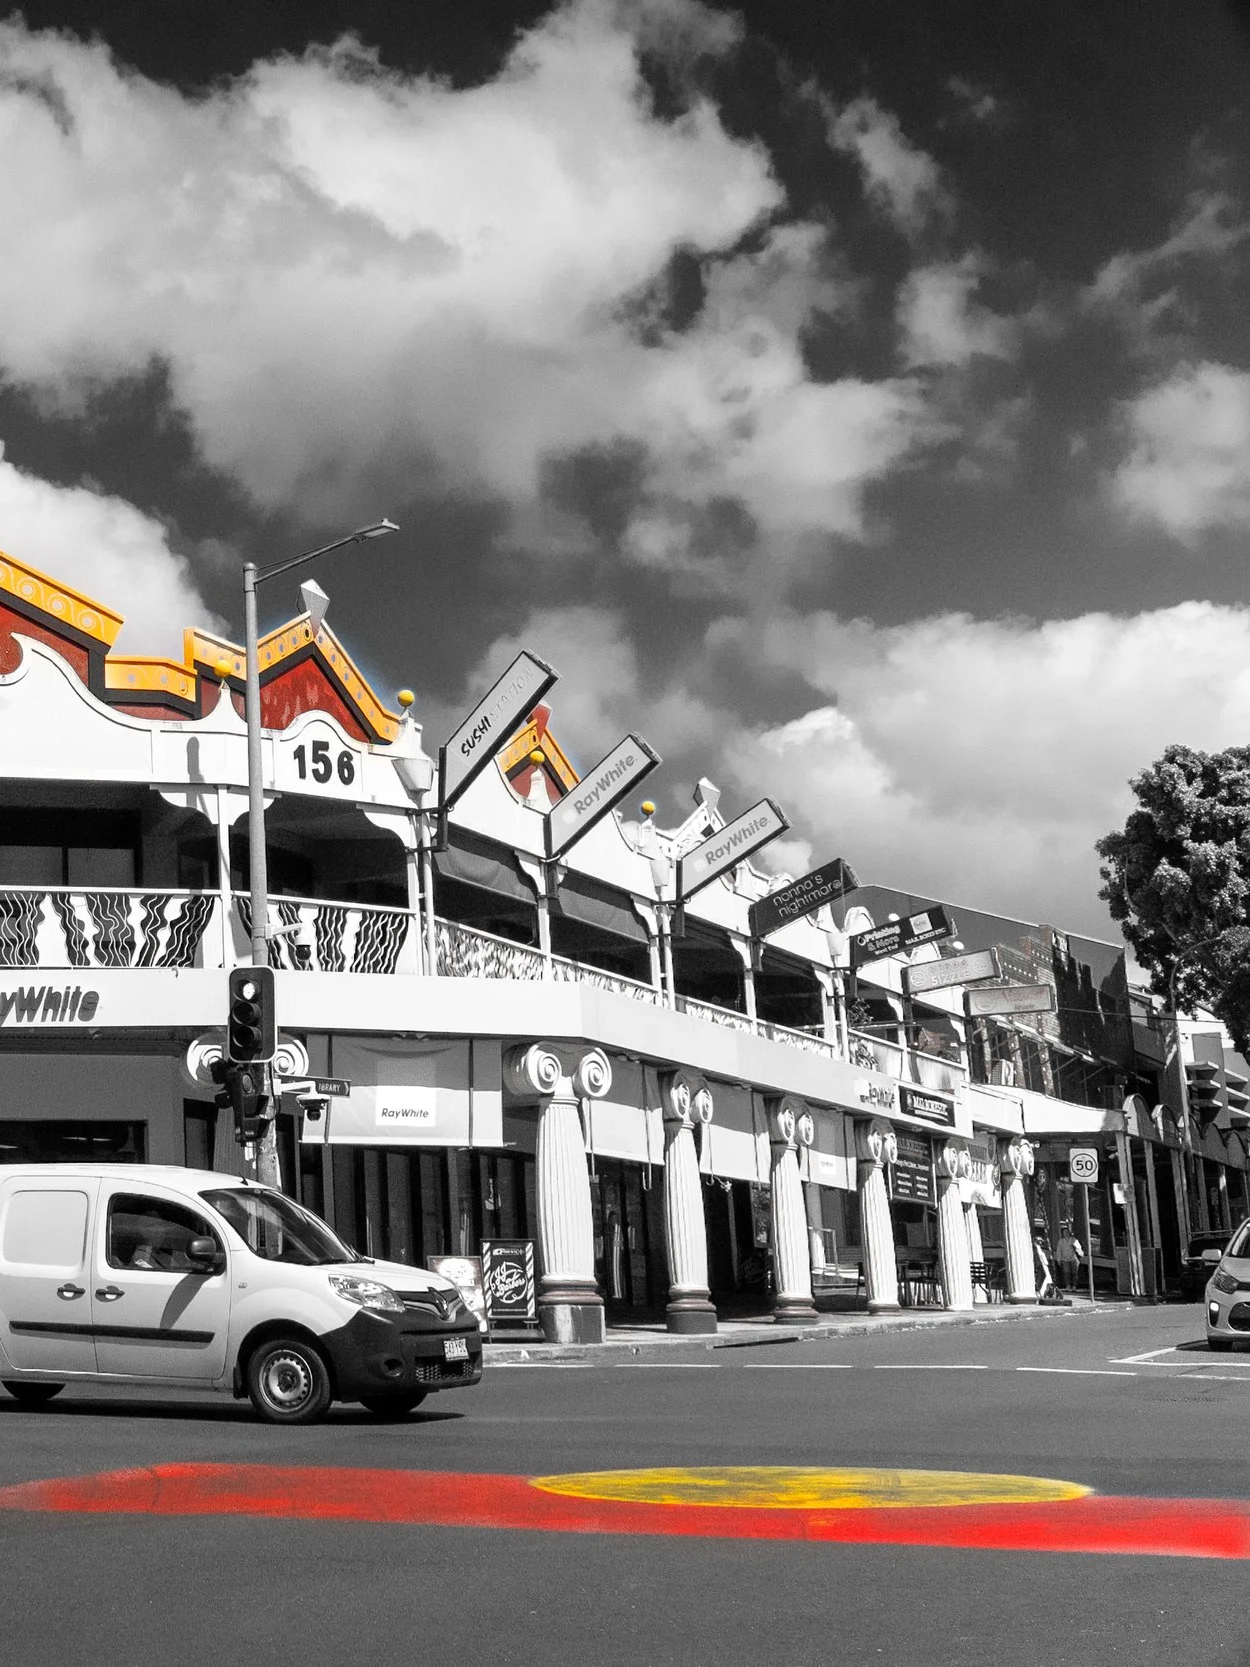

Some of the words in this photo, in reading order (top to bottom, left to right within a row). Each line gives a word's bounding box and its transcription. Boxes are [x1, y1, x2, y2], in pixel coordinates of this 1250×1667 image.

[461, 716, 491, 757] SUSHI
[293, 740, 355, 786] 156
[773, 875, 823, 906] nonna's
[931, 971, 970, 986] SIZZLE
[318, 1082, 341, 1093] IBRARY
[381, 1107, 429, 1119] RayWhite
[1076, 1160, 1093, 1171] 50
